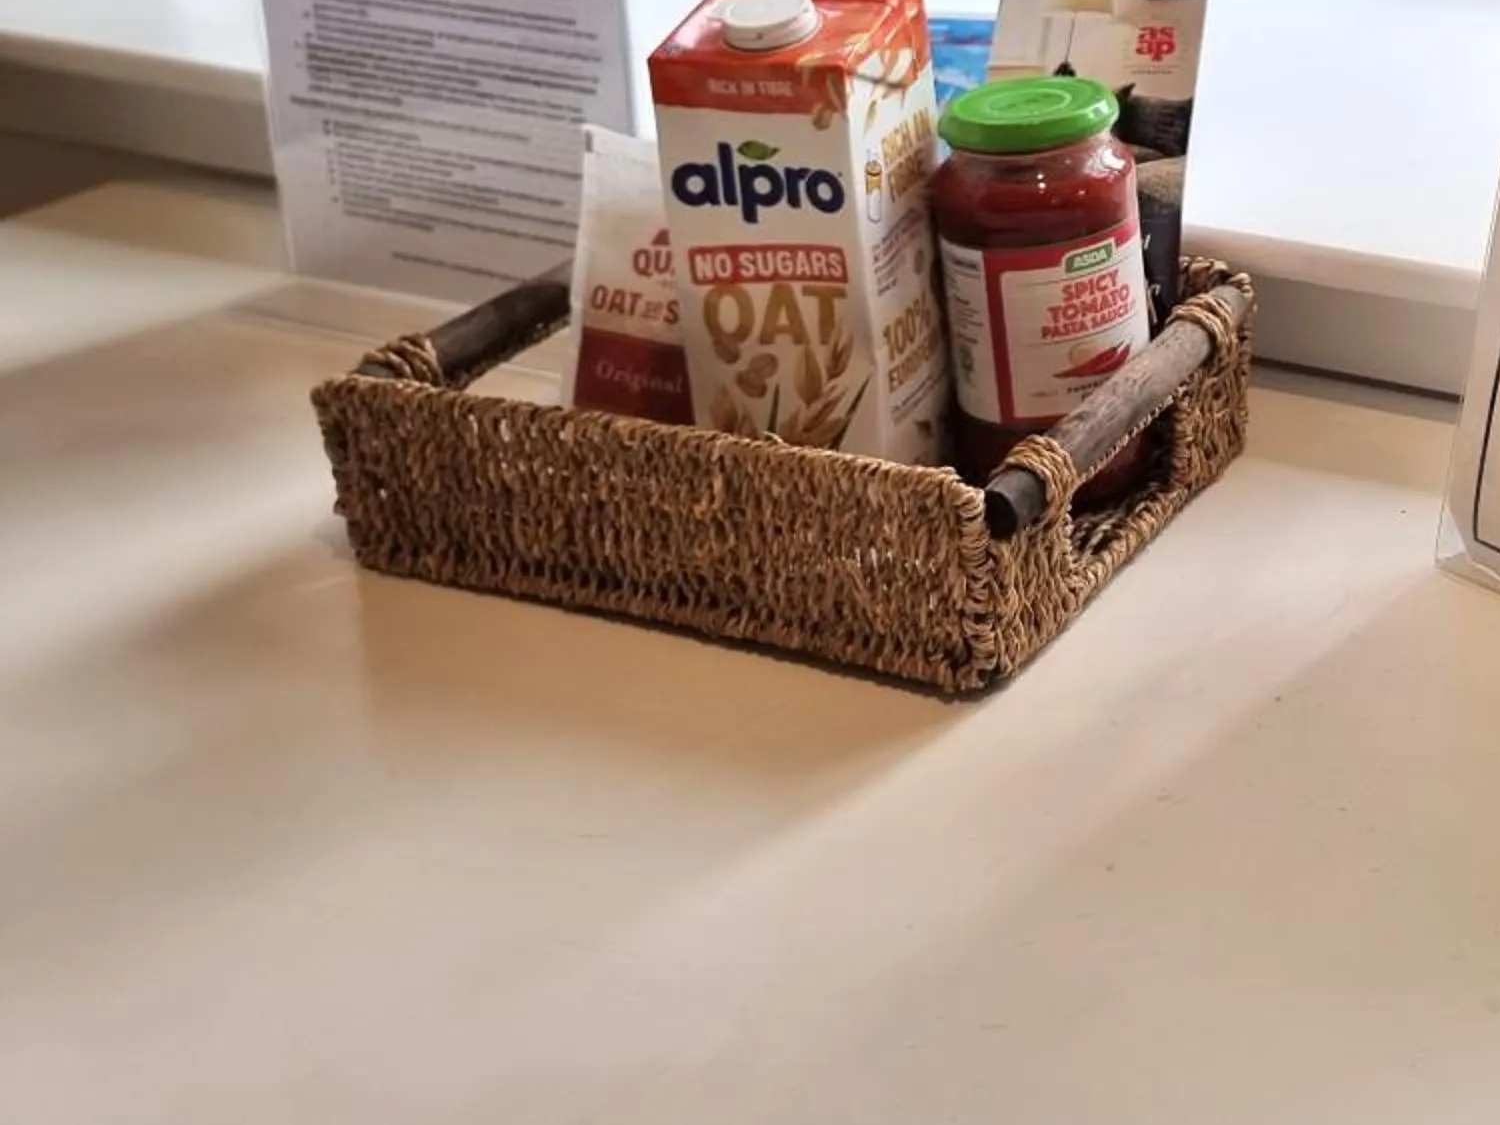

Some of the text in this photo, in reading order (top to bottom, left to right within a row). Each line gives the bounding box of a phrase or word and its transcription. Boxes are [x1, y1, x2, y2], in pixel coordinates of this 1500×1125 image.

[707, 78, 738, 95] RICH
[671, 141, 845, 224] alpro
[632, 248, 676, 278] QU
[694, 250, 845, 279] NO SUGARS
[1070, 249, 1111, 271] ASDA
[590, 284, 643, 316] OAT
[1061, 269, 1120, 303] SPICY
[702, 283, 847, 347] OAT
[1047, 284, 1132, 325] TOMATO
[1040, 306, 1134, 341] PASTA SAUCE
